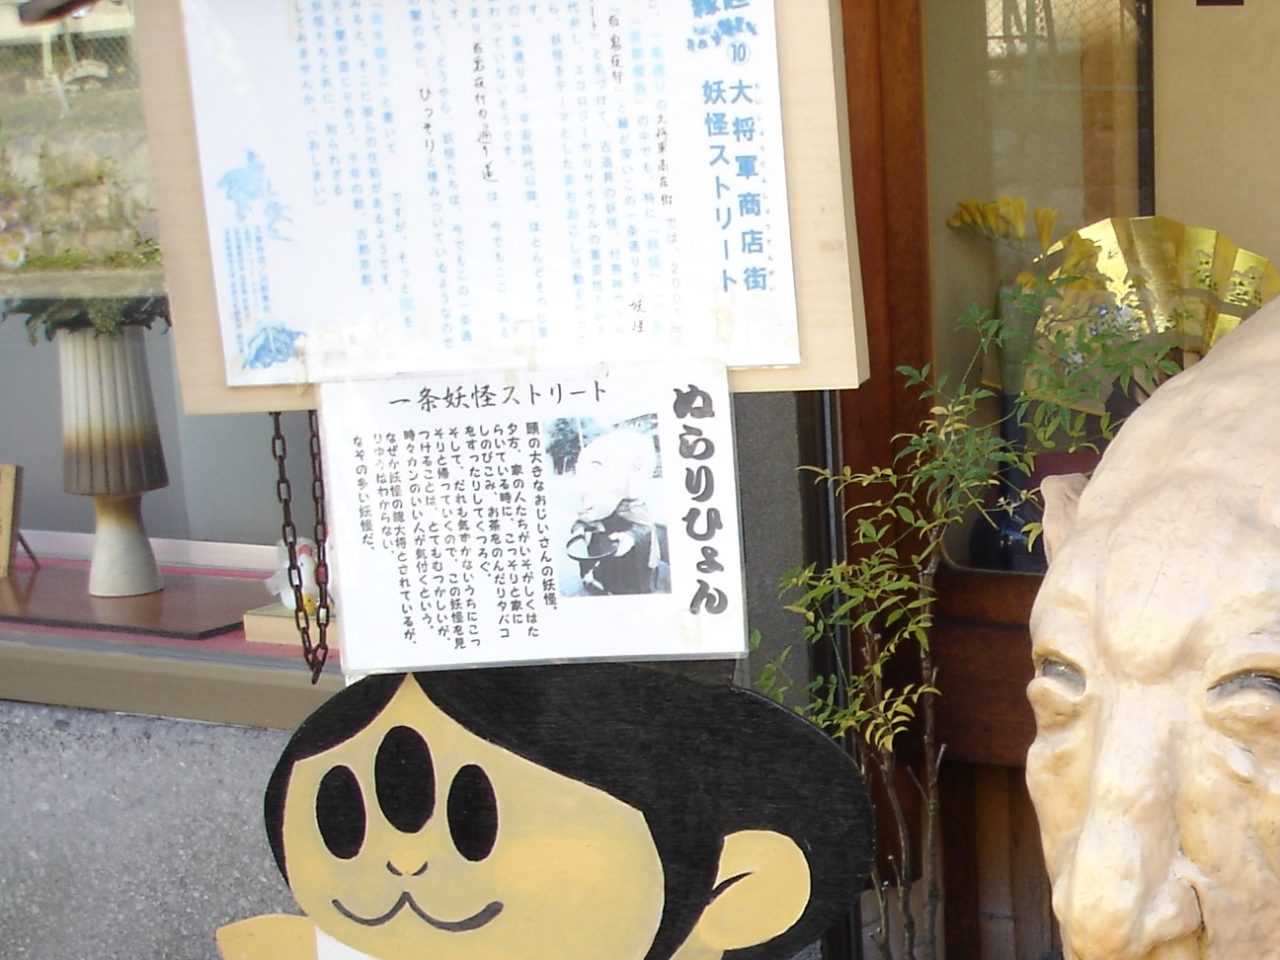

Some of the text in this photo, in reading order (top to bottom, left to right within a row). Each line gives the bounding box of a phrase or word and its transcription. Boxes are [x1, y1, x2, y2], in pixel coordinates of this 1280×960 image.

[701, 79, 738, 293] 妖怪ストリート
[730, 79, 768, 292] 大将軍商店街
[389, 380, 607, 411] 一条妖怪ストリート
[672, 384, 729, 616] ぬらりひょん
